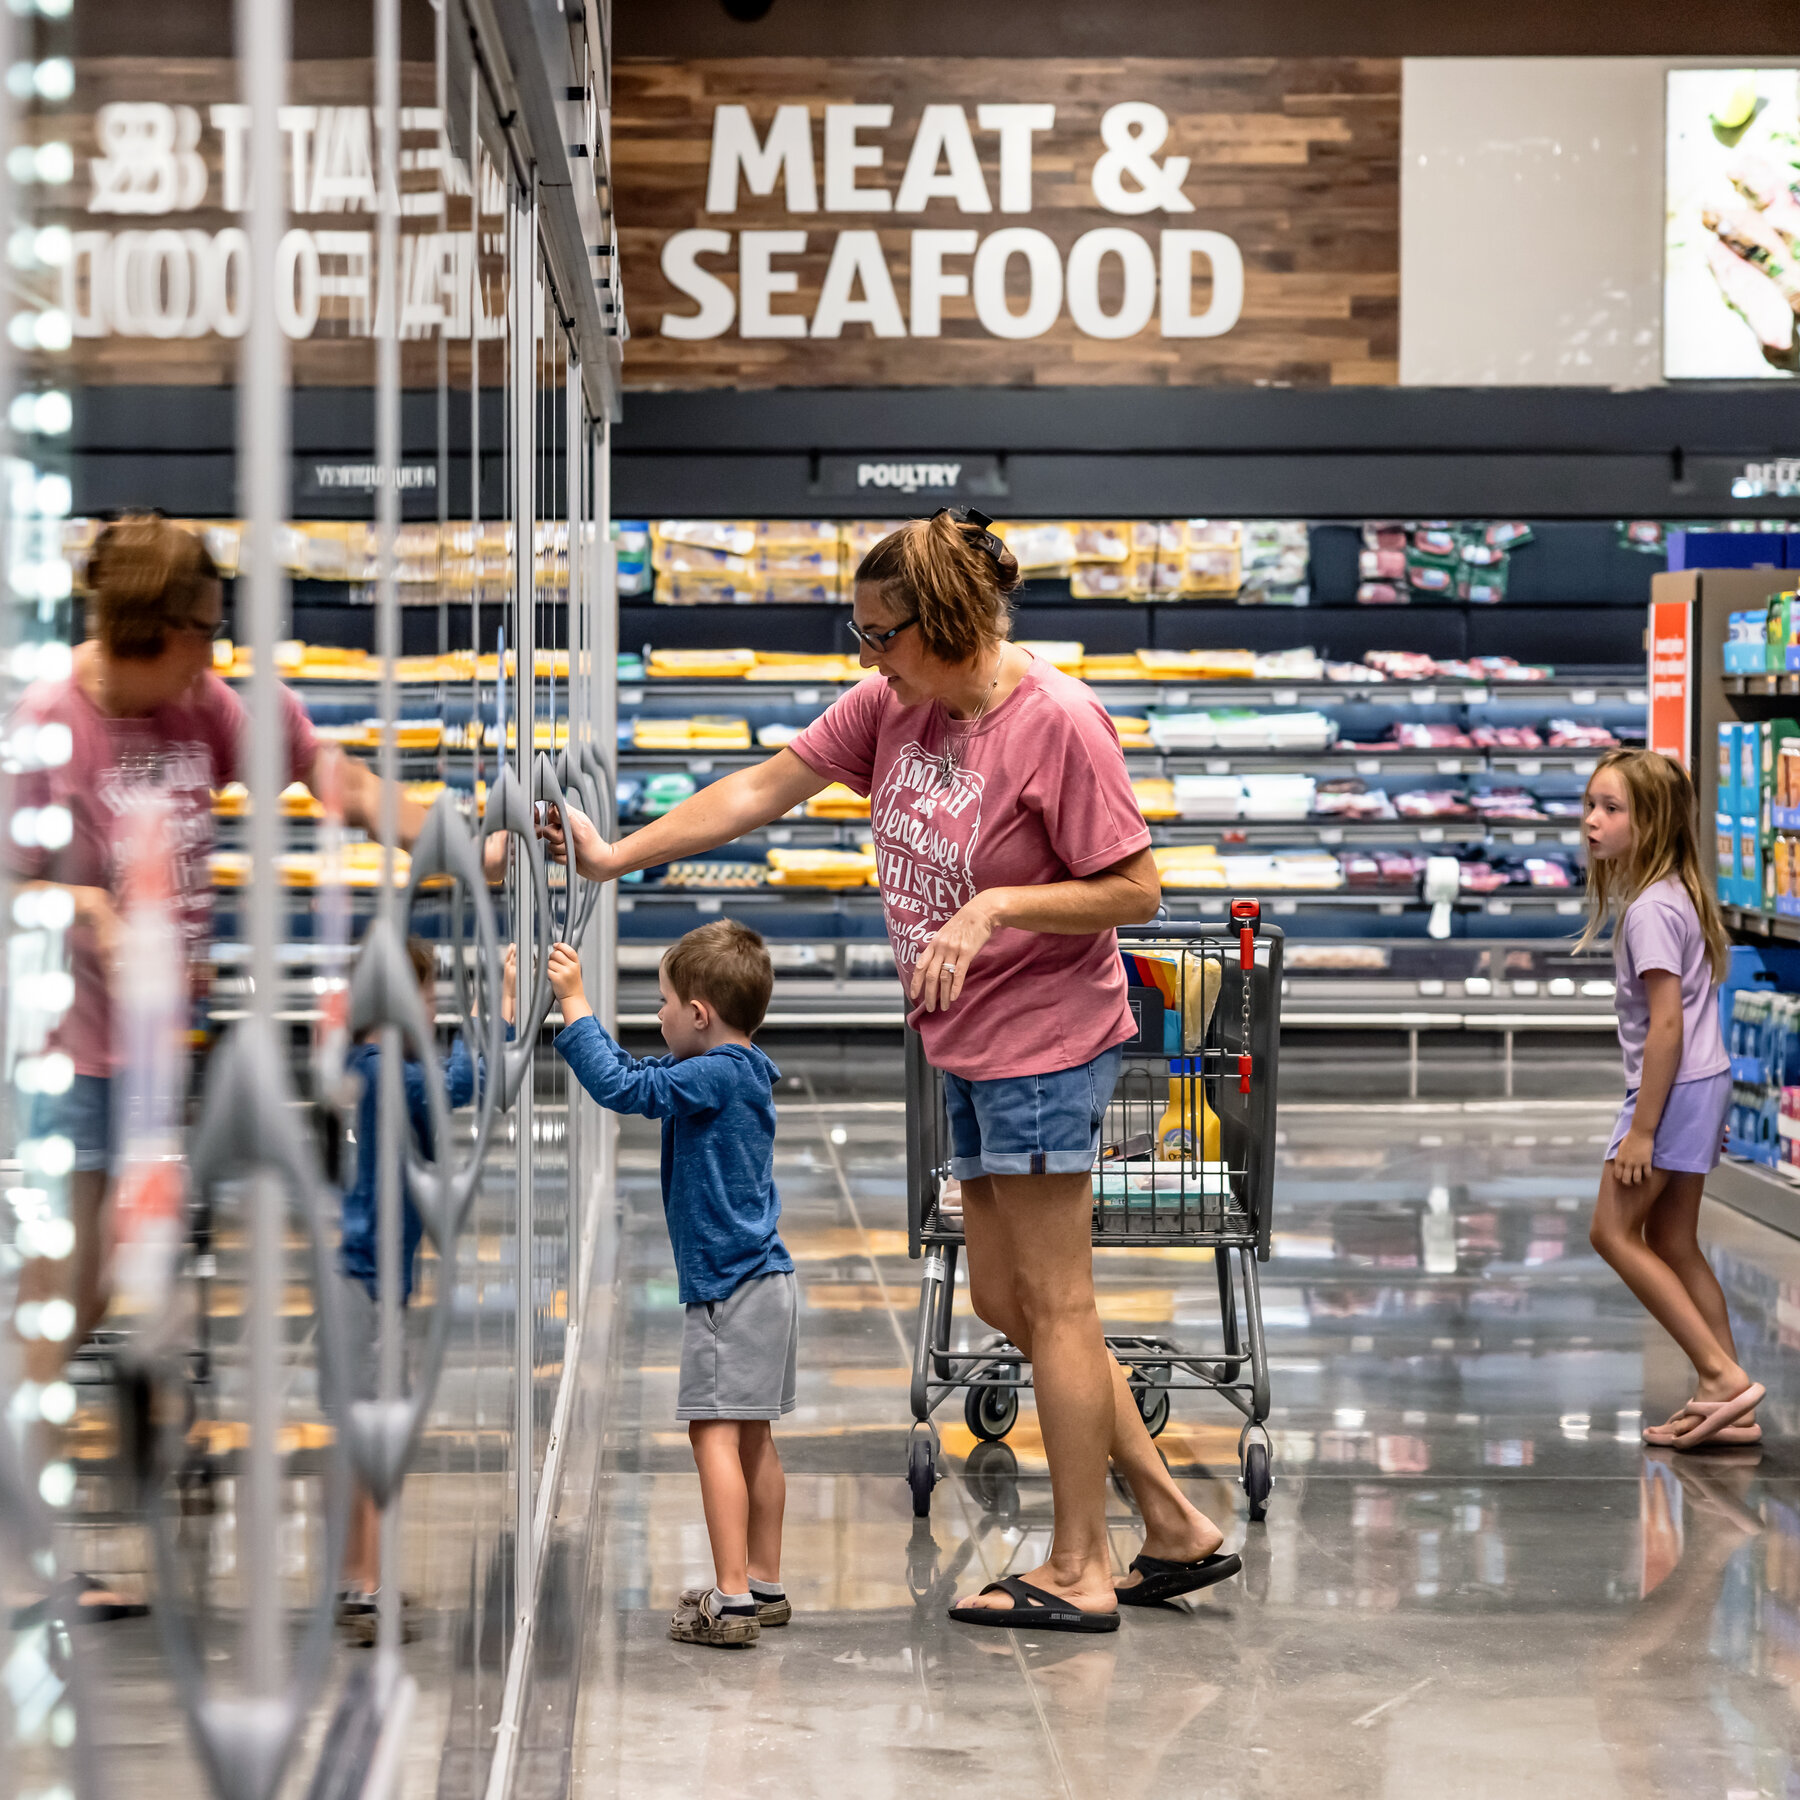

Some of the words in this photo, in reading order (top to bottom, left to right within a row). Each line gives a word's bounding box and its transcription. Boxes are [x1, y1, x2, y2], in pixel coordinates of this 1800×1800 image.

[706, 104, 1055, 213] MEAT
[1091, 101, 1195, 215] &
[660, 227, 1245, 340] SEAFOOD
[858, 463, 961, 488] POULTRY
[910, 794, 937, 819] AS
[876, 846, 963, 909] WHISKEY
[884, 889, 930, 917] WEET
